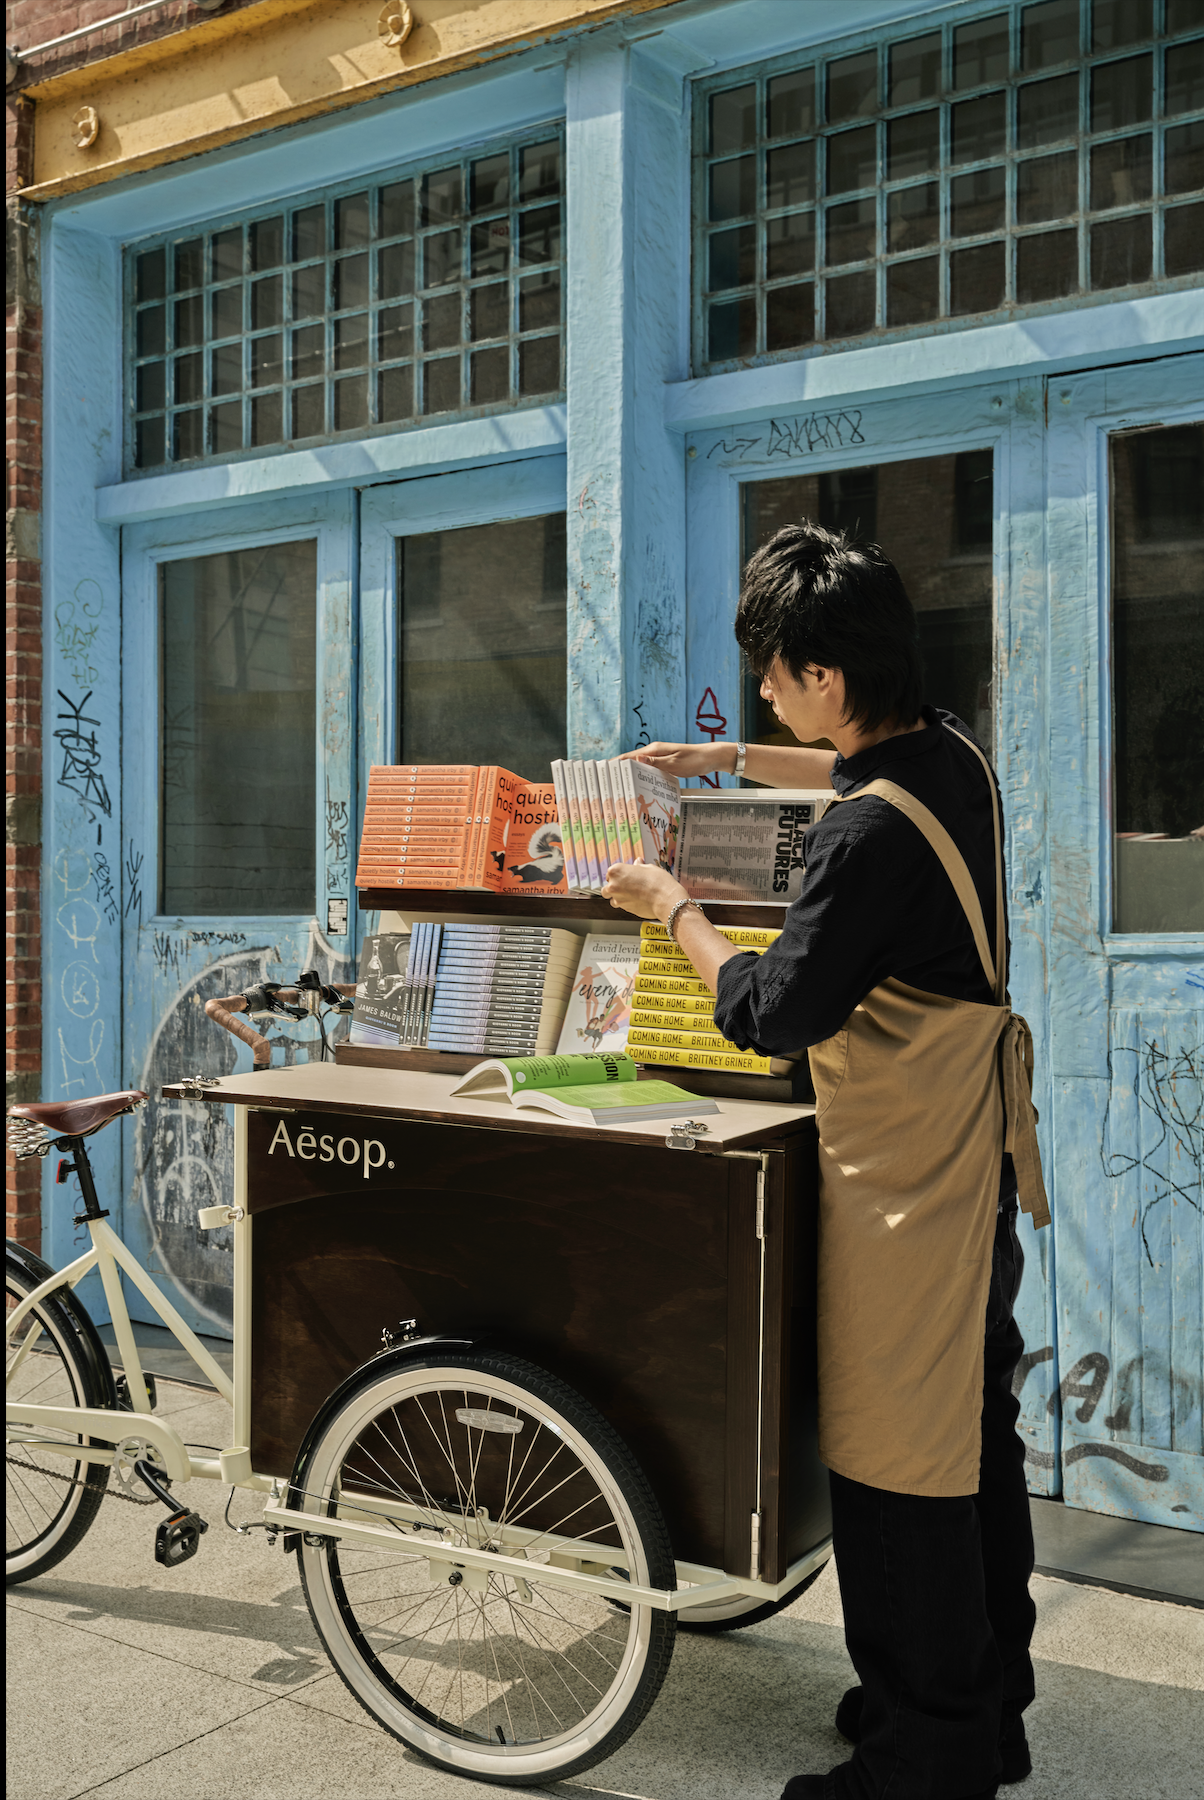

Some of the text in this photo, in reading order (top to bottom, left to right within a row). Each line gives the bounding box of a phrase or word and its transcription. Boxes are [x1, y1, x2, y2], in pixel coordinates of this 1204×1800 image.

[638, 771, 654, 784] david
[517, 790, 557, 807] quie
[514, 810, 559, 824] hosti
[790, 805, 811, 870] BLACK
[773, 805, 794, 893] FUTURES
[646, 926, 668, 936] COMIN
[740, 932, 767, 943] GRINER
[593, 943, 641, 954] david levit
[645, 944, 685, 955] COMING HO
[611, 954, 630, 963] dion
[644, 961, 693, 973] COMING HOME
[639, 978, 667, 989] COMING
[669, 981, 689, 991] HOME
[579, 980, 635, 1008] every da
[637, 996, 715, 1010] COMING HOME BRITT
[358, 1004, 402, 1022] JAMES BALDW
[634, 1013, 718, 1029] COMING HOME BRITT
[632, 1031, 660, 1042] COMING
[662, 1034, 683, 1044] HOME
[692, 1036, 727, 1048] BRITTNEY
[629, 1048, 657, 1060] COMING
[659, 1051, 680, 1062] HOME
[689, 1054, 723, 1066] BRITTNEY
[725, 1057, 752, 1068] GRINER
